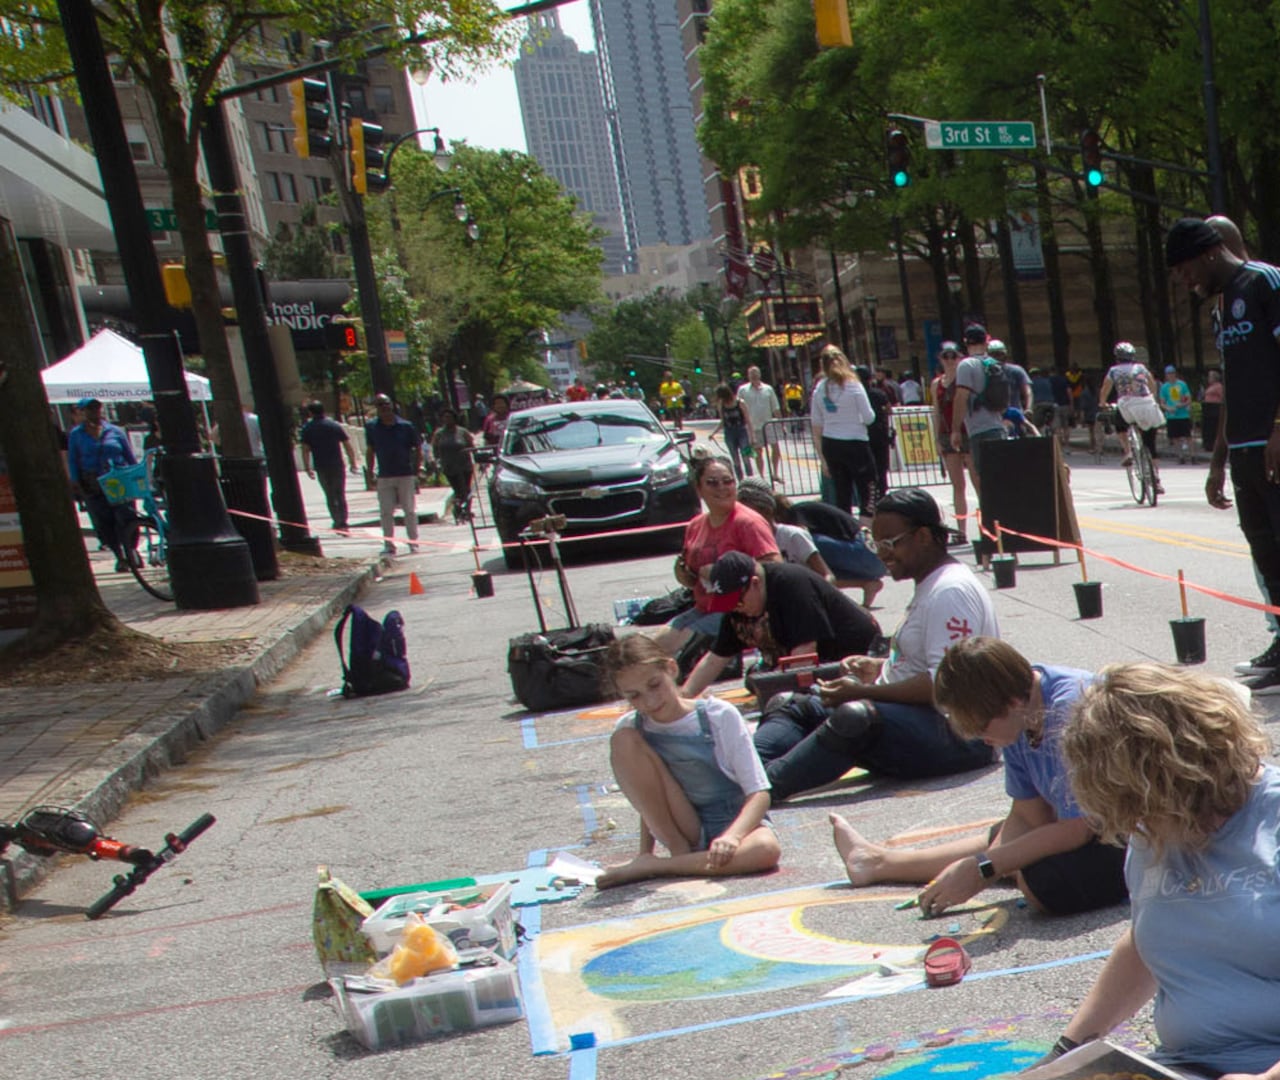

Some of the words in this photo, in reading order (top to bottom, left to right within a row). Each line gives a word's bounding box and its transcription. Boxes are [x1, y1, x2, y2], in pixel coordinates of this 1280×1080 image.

[944, 126, 969, 143] 3rd
[975, 126, 992, 143] St
[271, 301, 316, 315] hotel
